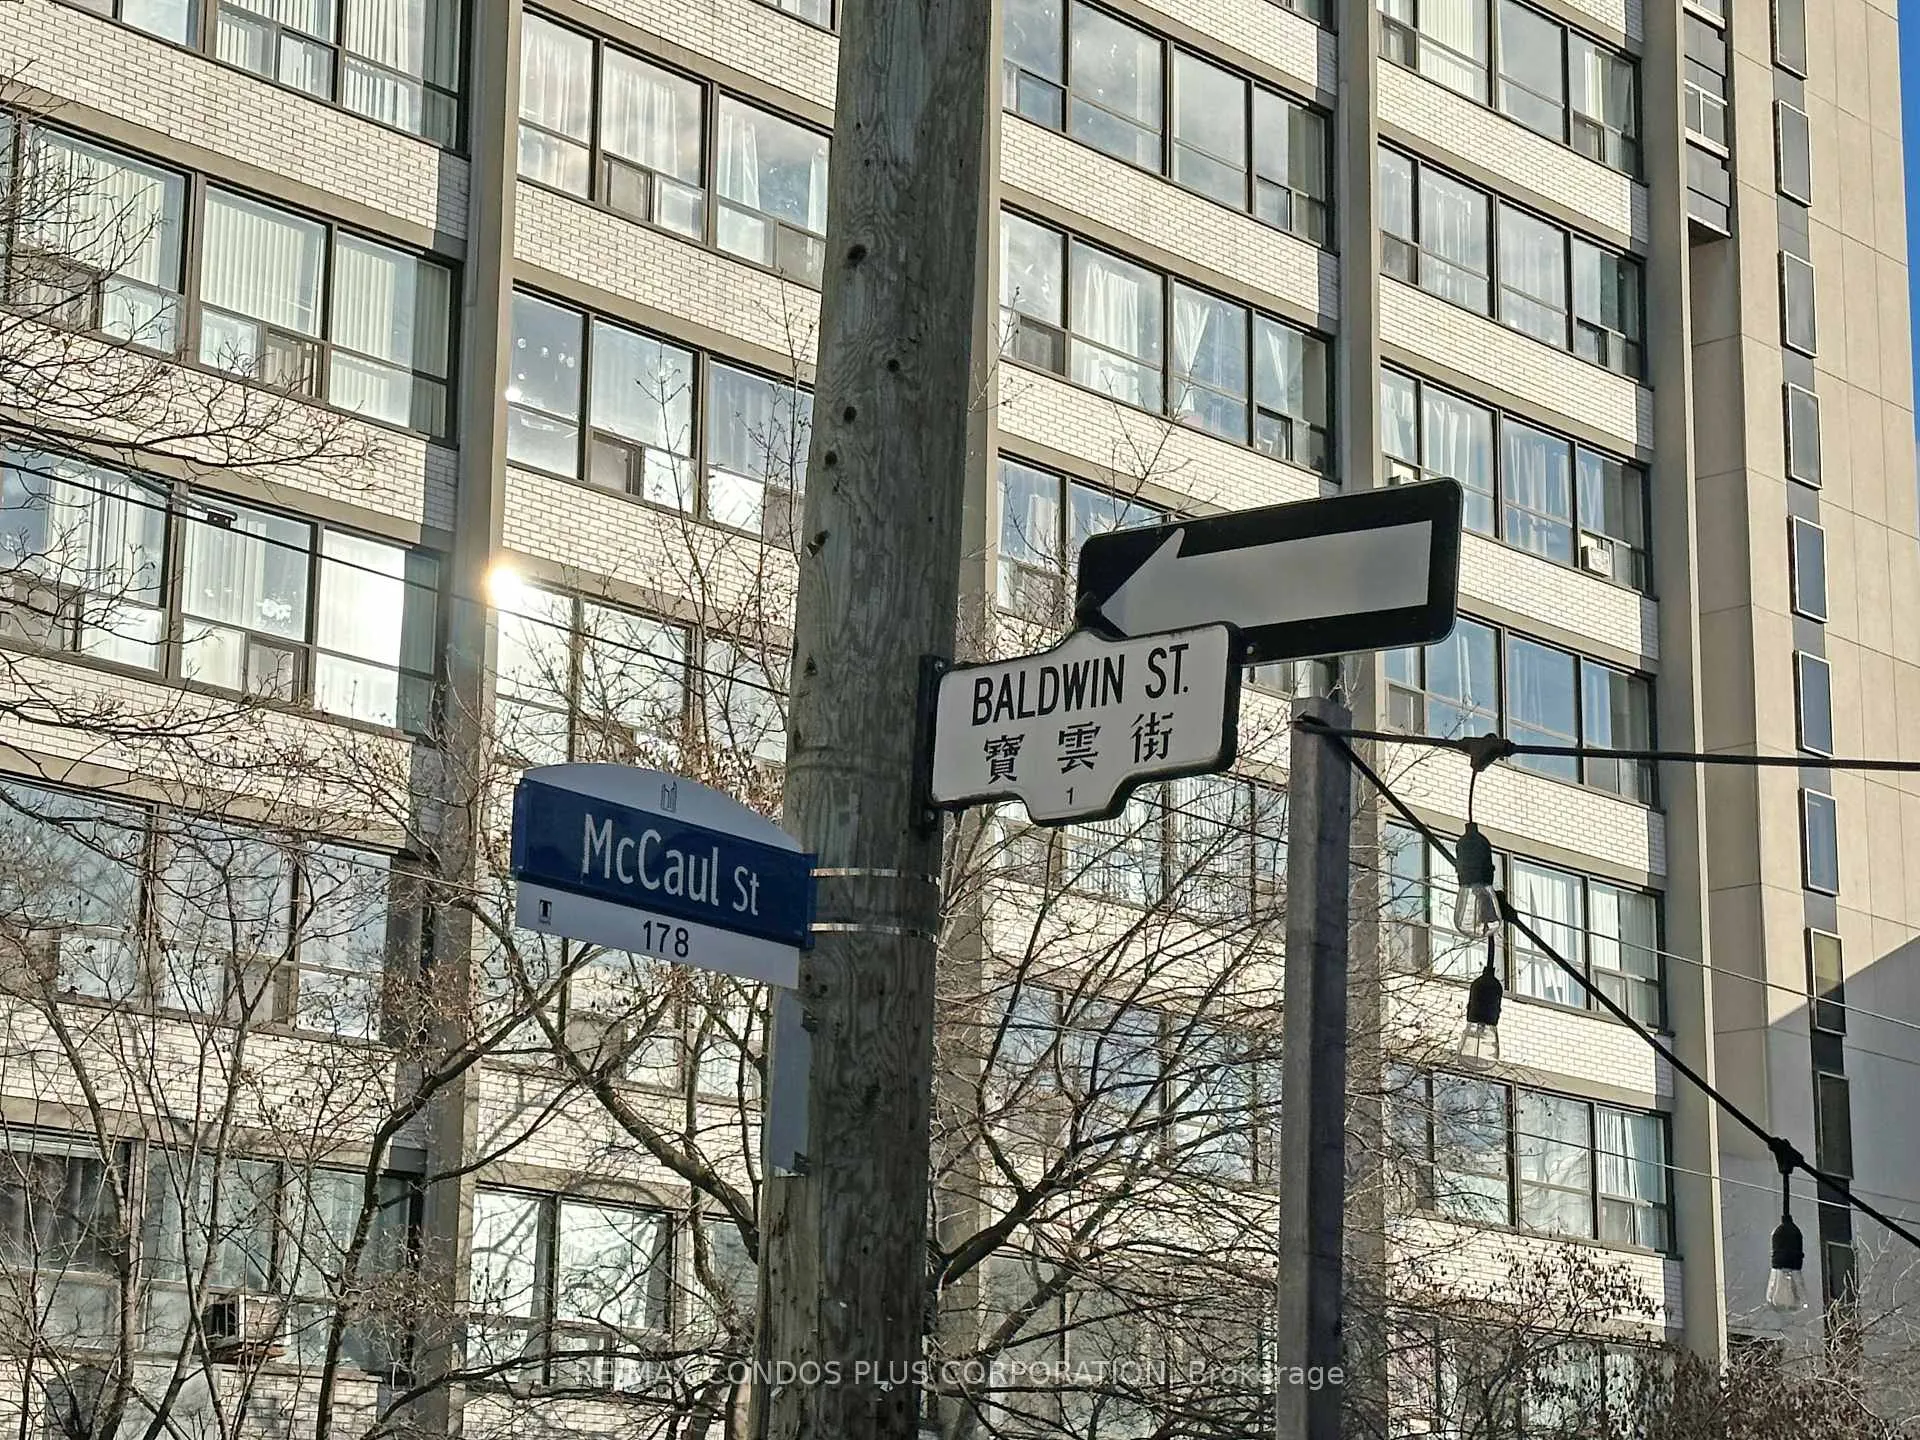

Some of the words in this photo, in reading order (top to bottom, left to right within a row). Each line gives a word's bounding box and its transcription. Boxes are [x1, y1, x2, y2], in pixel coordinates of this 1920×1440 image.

[972, 654, 1125, 726] BALDWIN
[1145, 643, 1189, 699] ST.
[983, 711, 1174, 785] 寶雲街
[1065, 787, 1074, 805] 1
[582, 813, 720, 906] McCaul
[732, 865, 760, 916] St
[642, 920, 690, 958] 178
